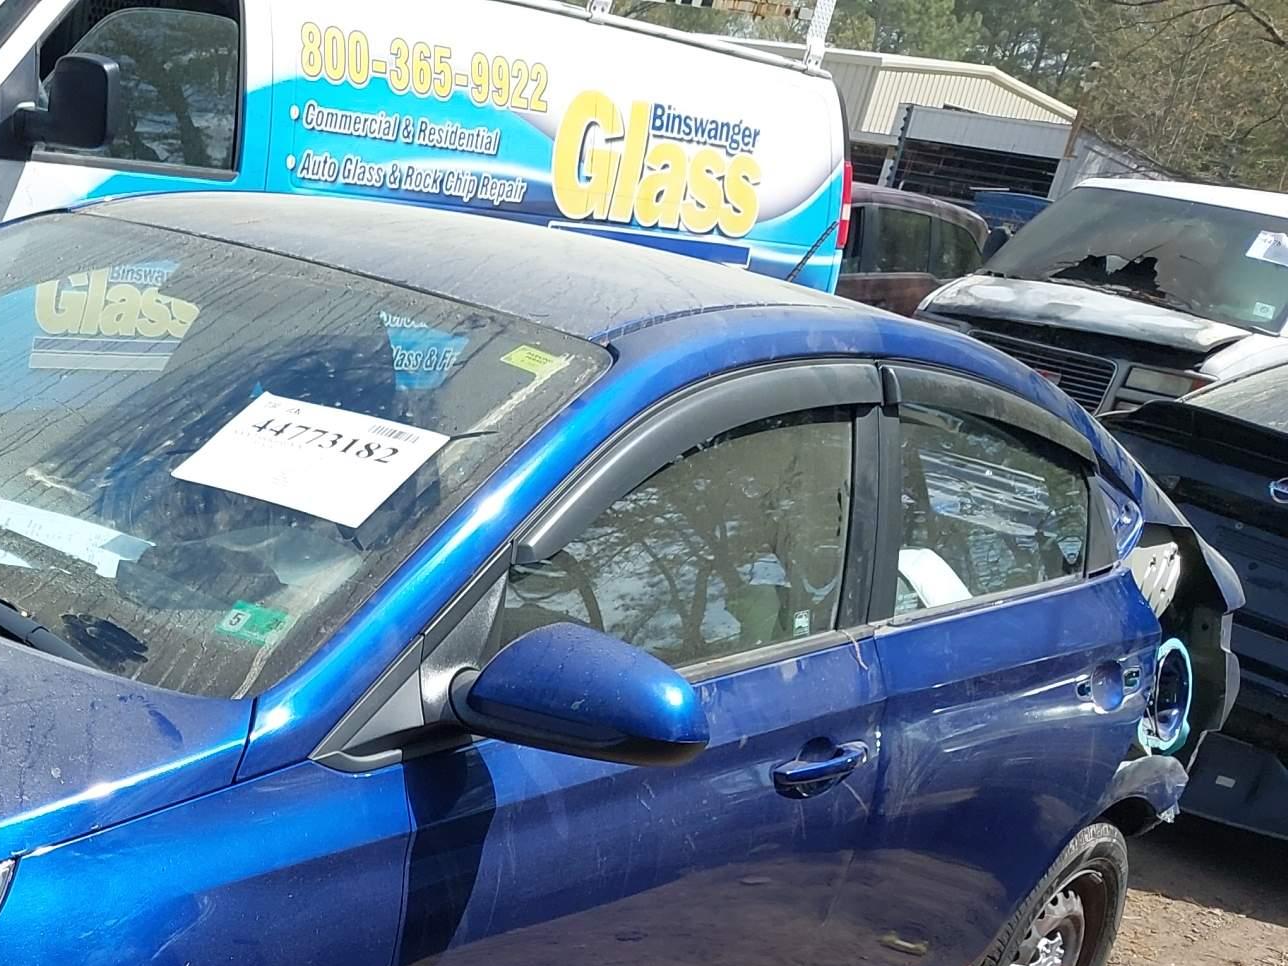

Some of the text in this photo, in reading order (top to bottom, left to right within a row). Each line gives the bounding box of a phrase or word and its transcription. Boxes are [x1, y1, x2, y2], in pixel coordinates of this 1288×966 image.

[300, 22, 549, 113] 800-365-9922
[304, 102, 500, 154] Commercial & Residential
[651, 102, 761, 151] Binswanger
[299, 151, 527, 205] Auto Glass & Rock Chip Repair
[553, 89, 761, 236] Glass
[391, 346, 421, 370] lass
[424, 347, 438, 370] &
[252, 418, 399, 464] 44773182
[229, 612, 245, 627] 5
